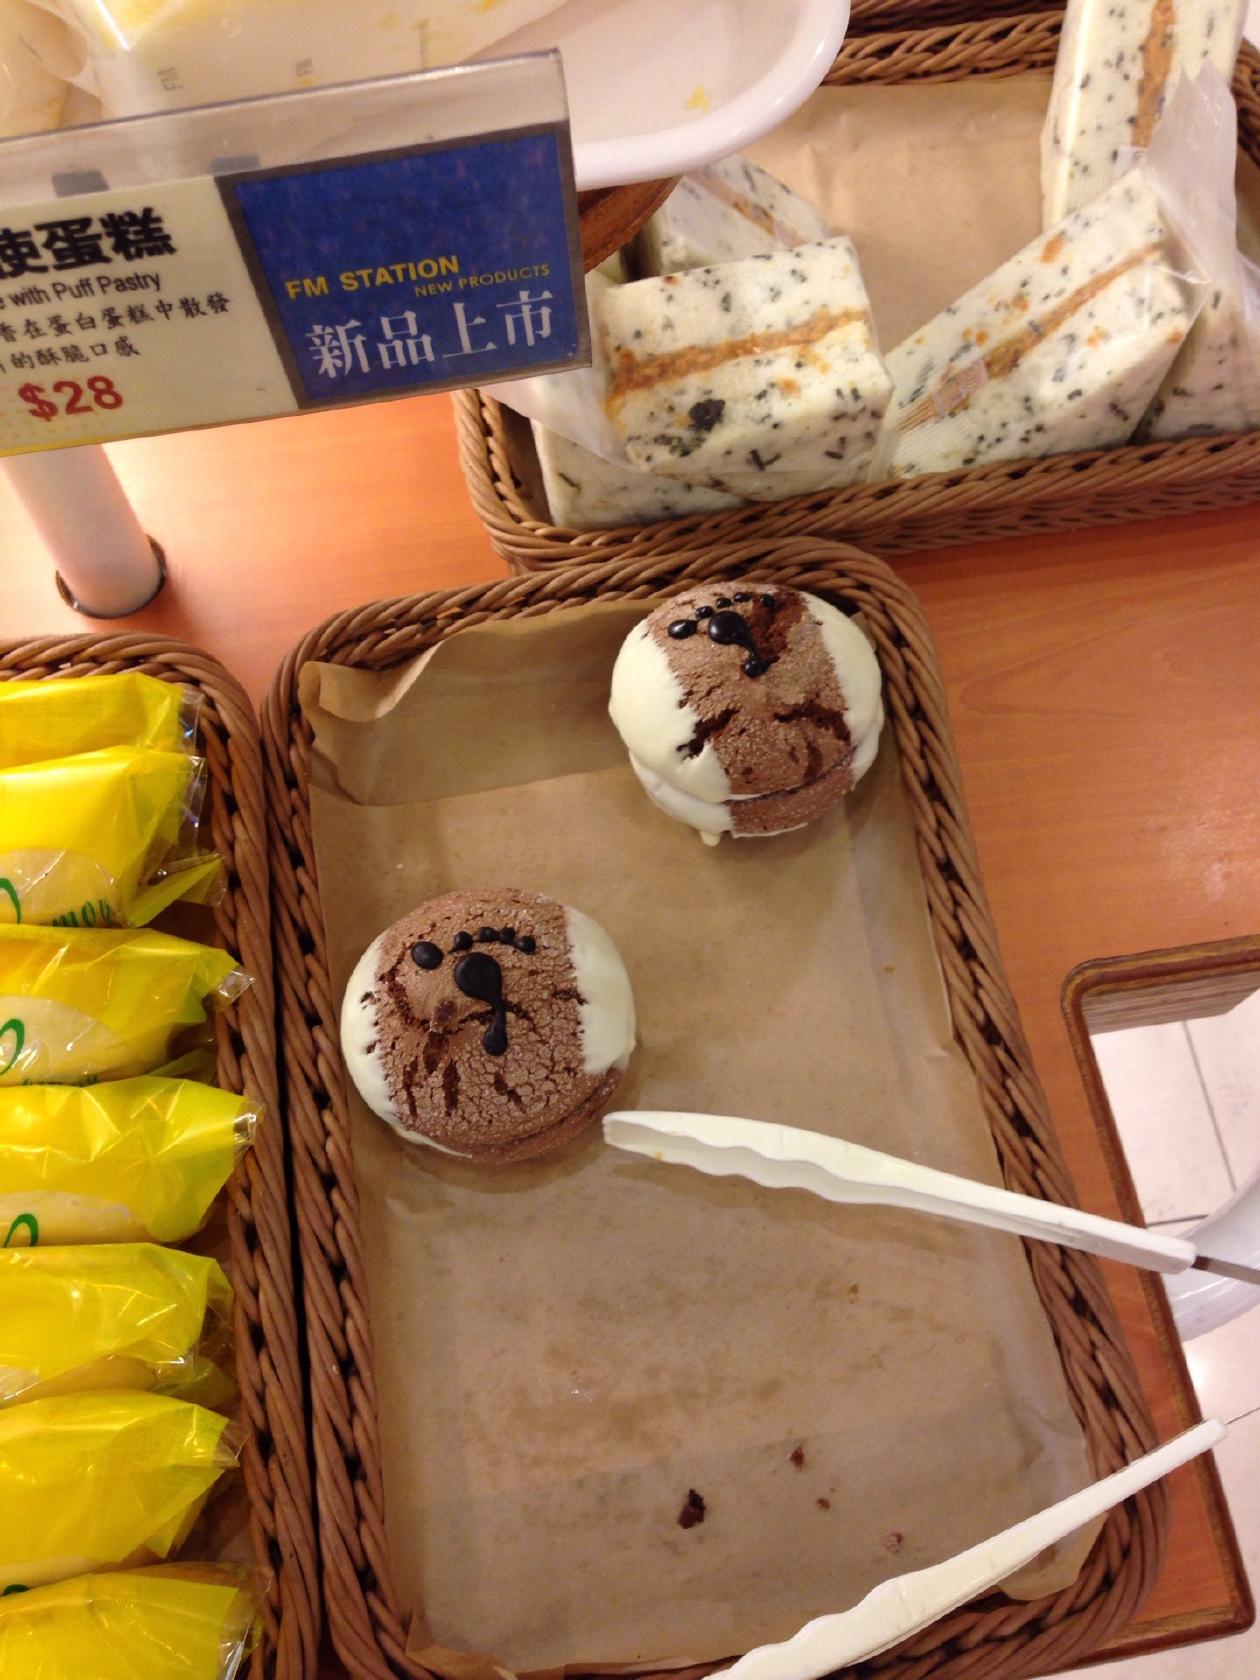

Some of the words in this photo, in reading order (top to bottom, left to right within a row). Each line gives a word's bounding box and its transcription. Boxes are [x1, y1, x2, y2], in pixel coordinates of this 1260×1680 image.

[9, 284, 51, 307] with
[52, 278, 96, 301] Puff
[97, 272, 162, 295] Pastry
[285, 276, 329, 300] FM
[340, 255, 460, 292] STATION
[414, 281, 452, 298] NEW
[459, 264, 551, 291] PRODUCTS
[0, 335, 140, 374] 的酥脆口感
[305, 290, 554, 378] 新品上市
[18, 376, 123, 421] $28
